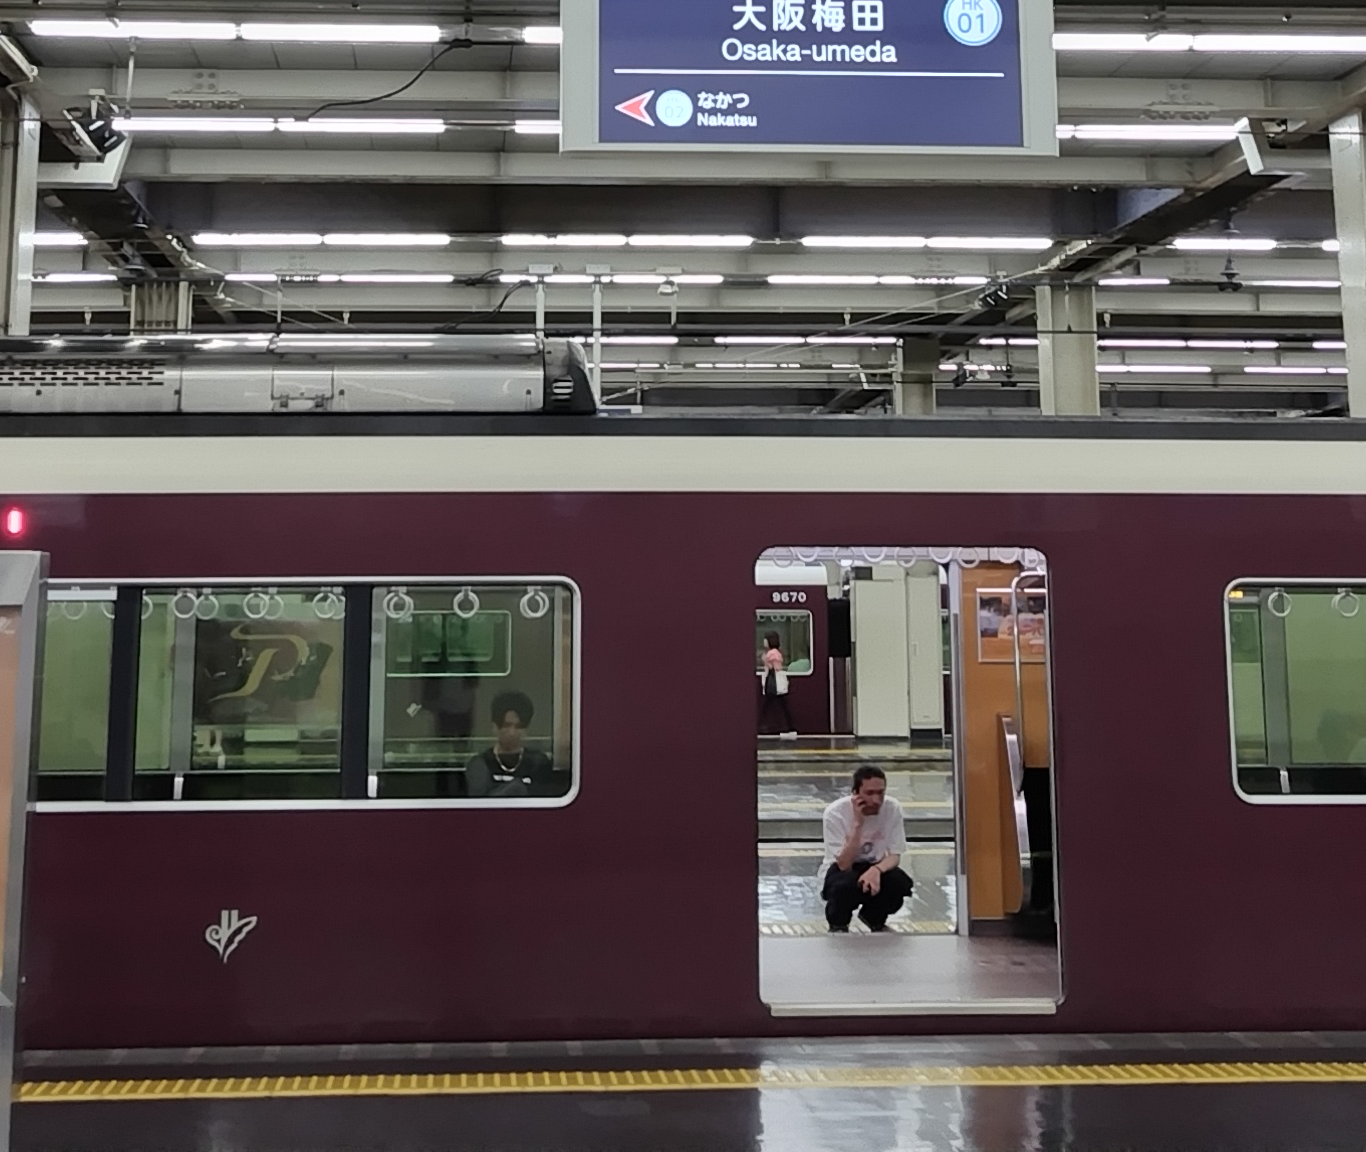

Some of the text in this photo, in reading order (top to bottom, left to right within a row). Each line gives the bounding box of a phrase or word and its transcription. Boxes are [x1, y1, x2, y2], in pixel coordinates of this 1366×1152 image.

[957, 12, 984, 34] 01
[721, 39, 898, 64] Osaka-umeda
[697, 91, 750, 109] なかつ
[697, 112, 758, 127] Nakatsu
[772, 591, 807, 603] 9670
